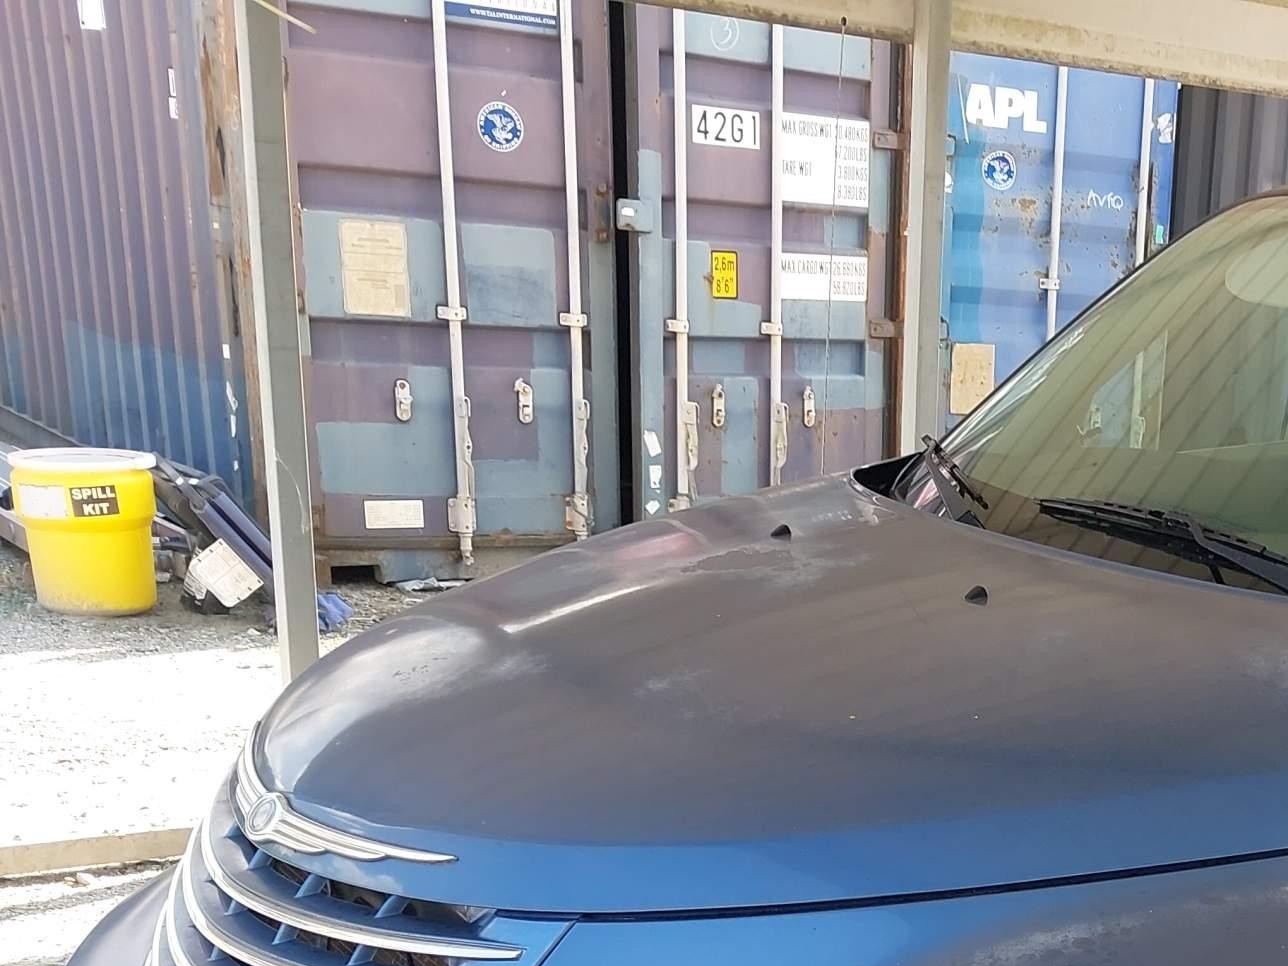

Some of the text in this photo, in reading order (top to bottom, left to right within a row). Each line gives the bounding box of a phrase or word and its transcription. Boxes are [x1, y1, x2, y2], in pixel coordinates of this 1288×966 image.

[966, 83, 1048, 134] APL
[697, 110, 757, 146] 42G1
[781, 119, 797, 135] MAX
[799, 120, 818, 138] GROSS
[782, 159, 797, 176] TARE
[781, 259, 795, 273] MAX
[798, 260, 817, 275] CARGO
[71, 487, 116, 501] SPILL
[82, 503, 110, 516] KIT
